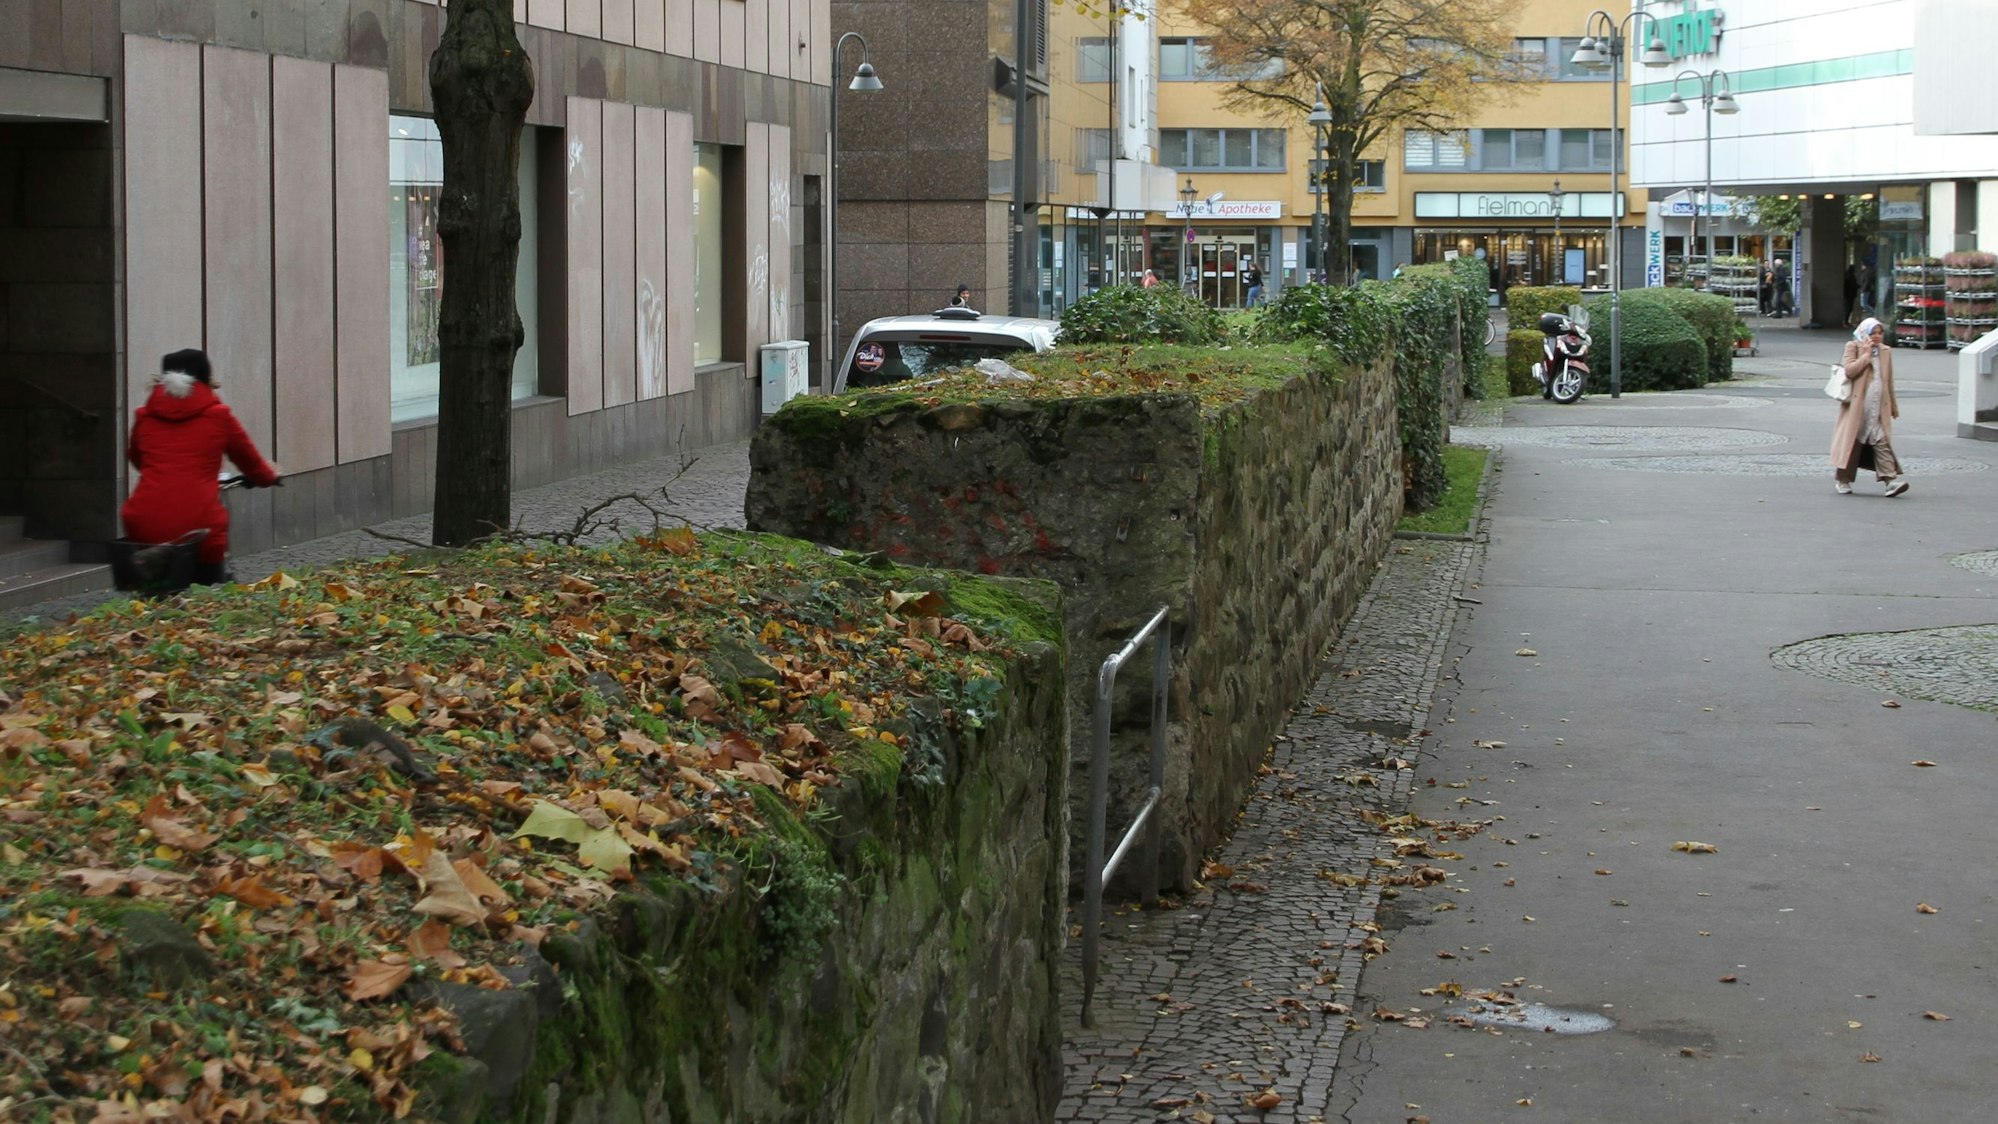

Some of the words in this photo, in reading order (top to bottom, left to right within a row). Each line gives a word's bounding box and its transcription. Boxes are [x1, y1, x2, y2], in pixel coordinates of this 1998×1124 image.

[1176, 204, 1205, 214] Nue
[1218, 203, 1272, 216] Apotheke
[1649, 230, 1661, 288] ackWERK
